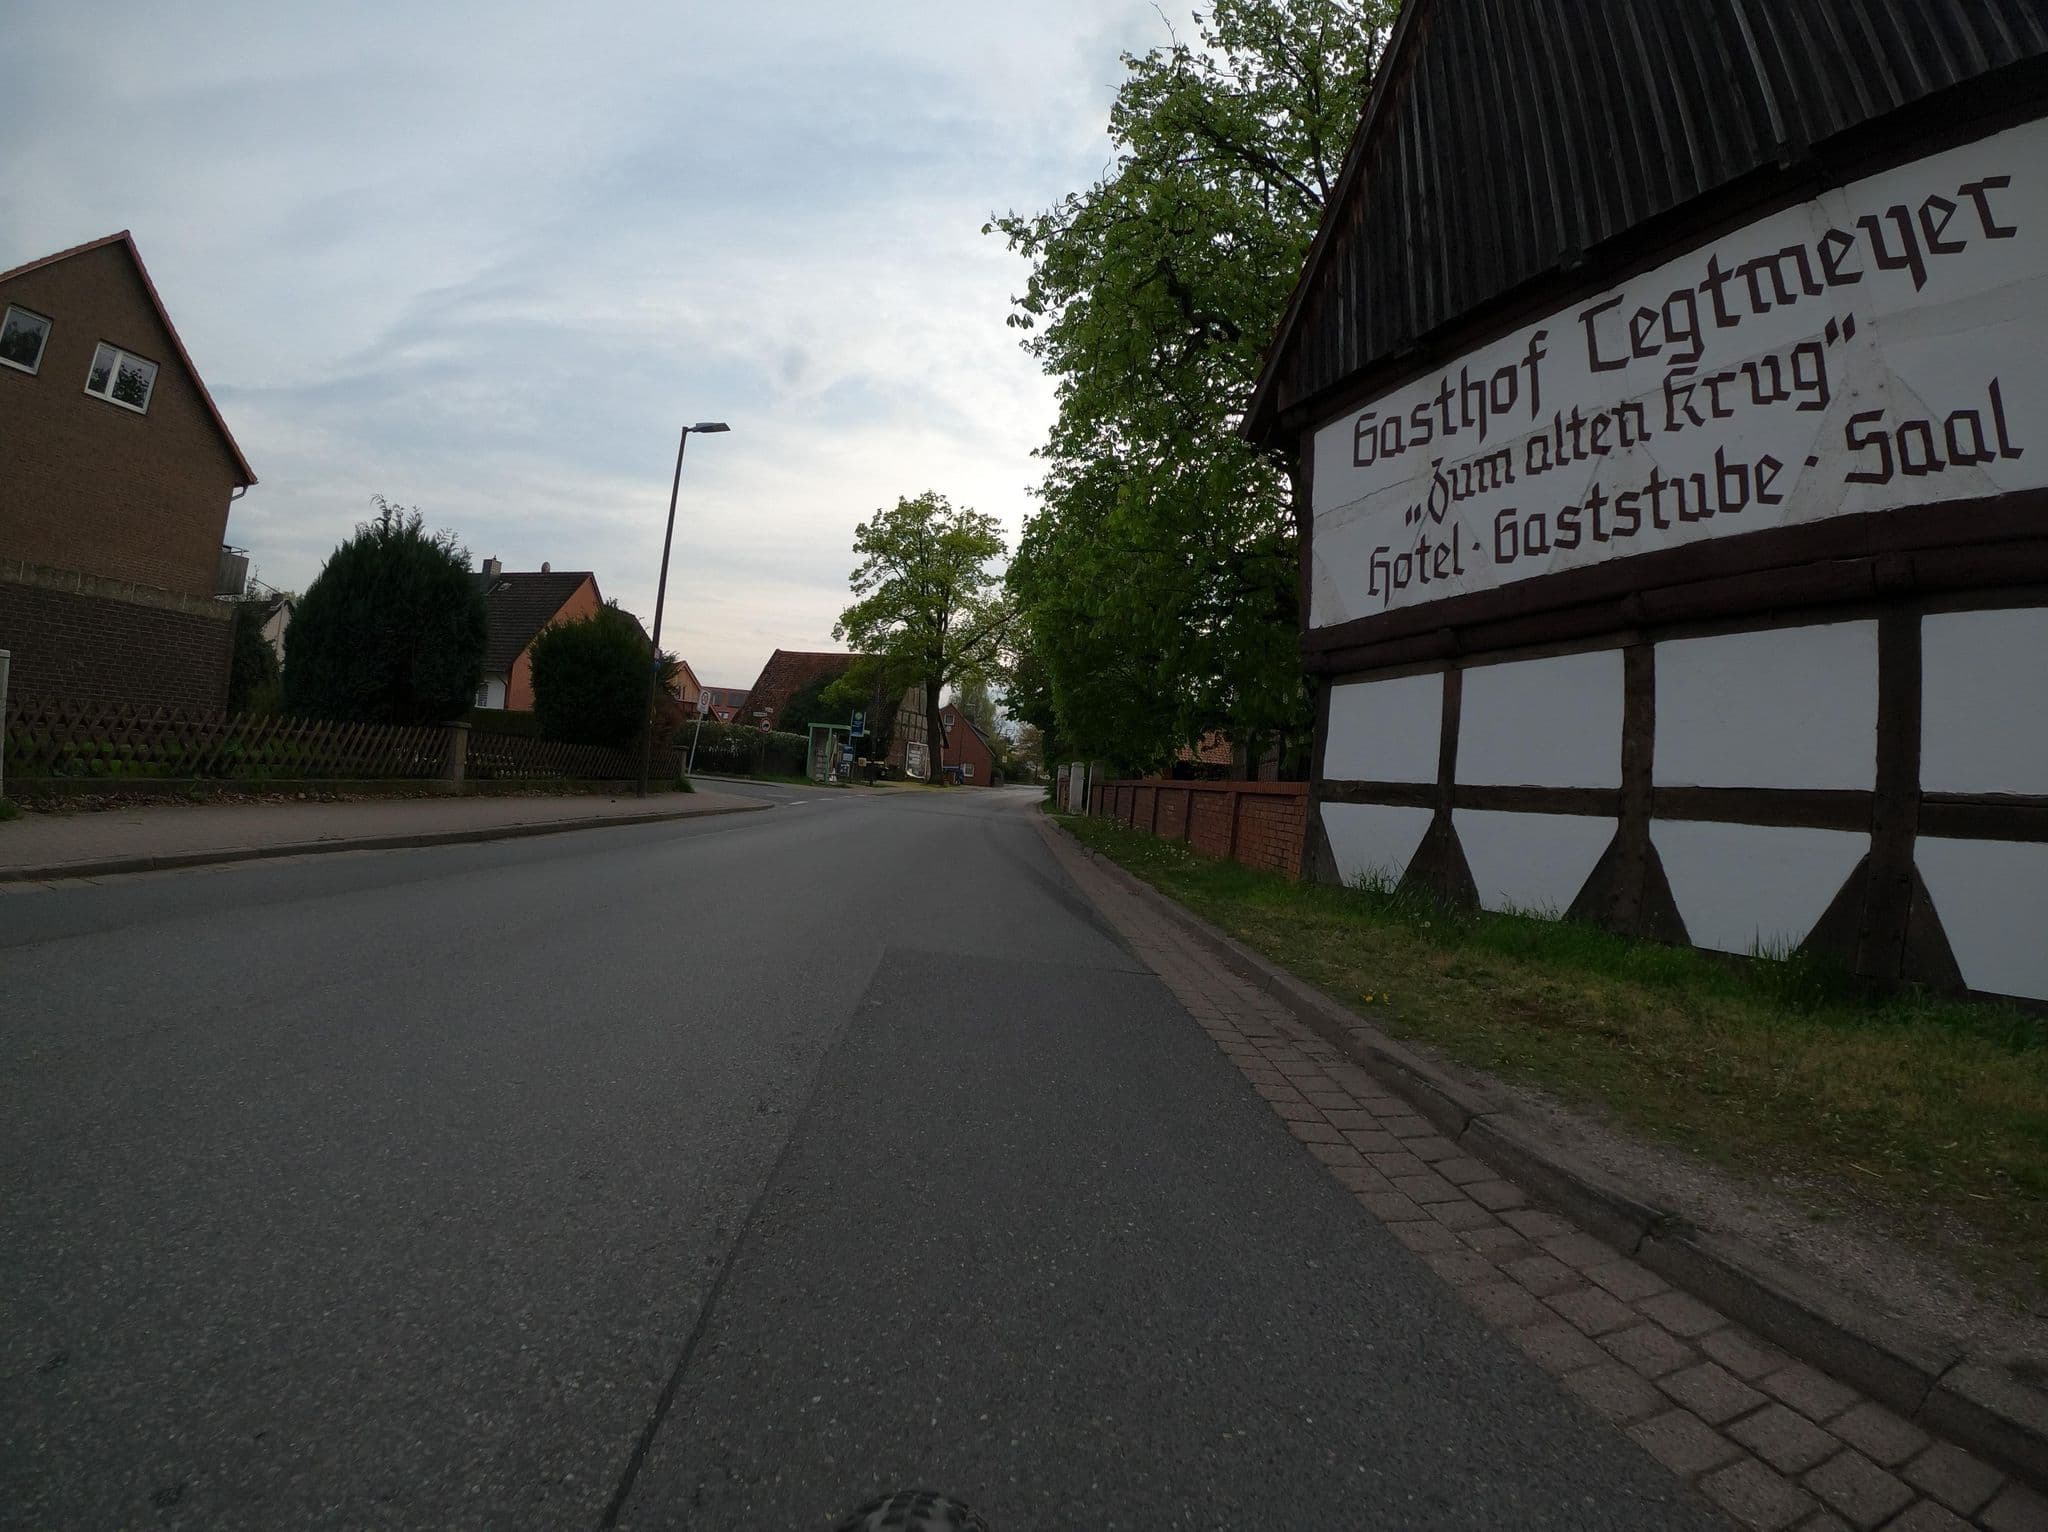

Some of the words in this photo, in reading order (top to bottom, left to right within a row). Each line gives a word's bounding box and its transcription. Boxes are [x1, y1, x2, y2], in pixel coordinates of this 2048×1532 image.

[1352, 330, 1549, 468] Gasthof
[1578, 174, 2018, 374] Tegtmeyer
[1367, 520, 1465, 609] Hotel
[1493, 444, 1785, 564] Gaststube
[1844, 376, 2025, 486] Saal
[1525, 402, 1653, 476] alten
